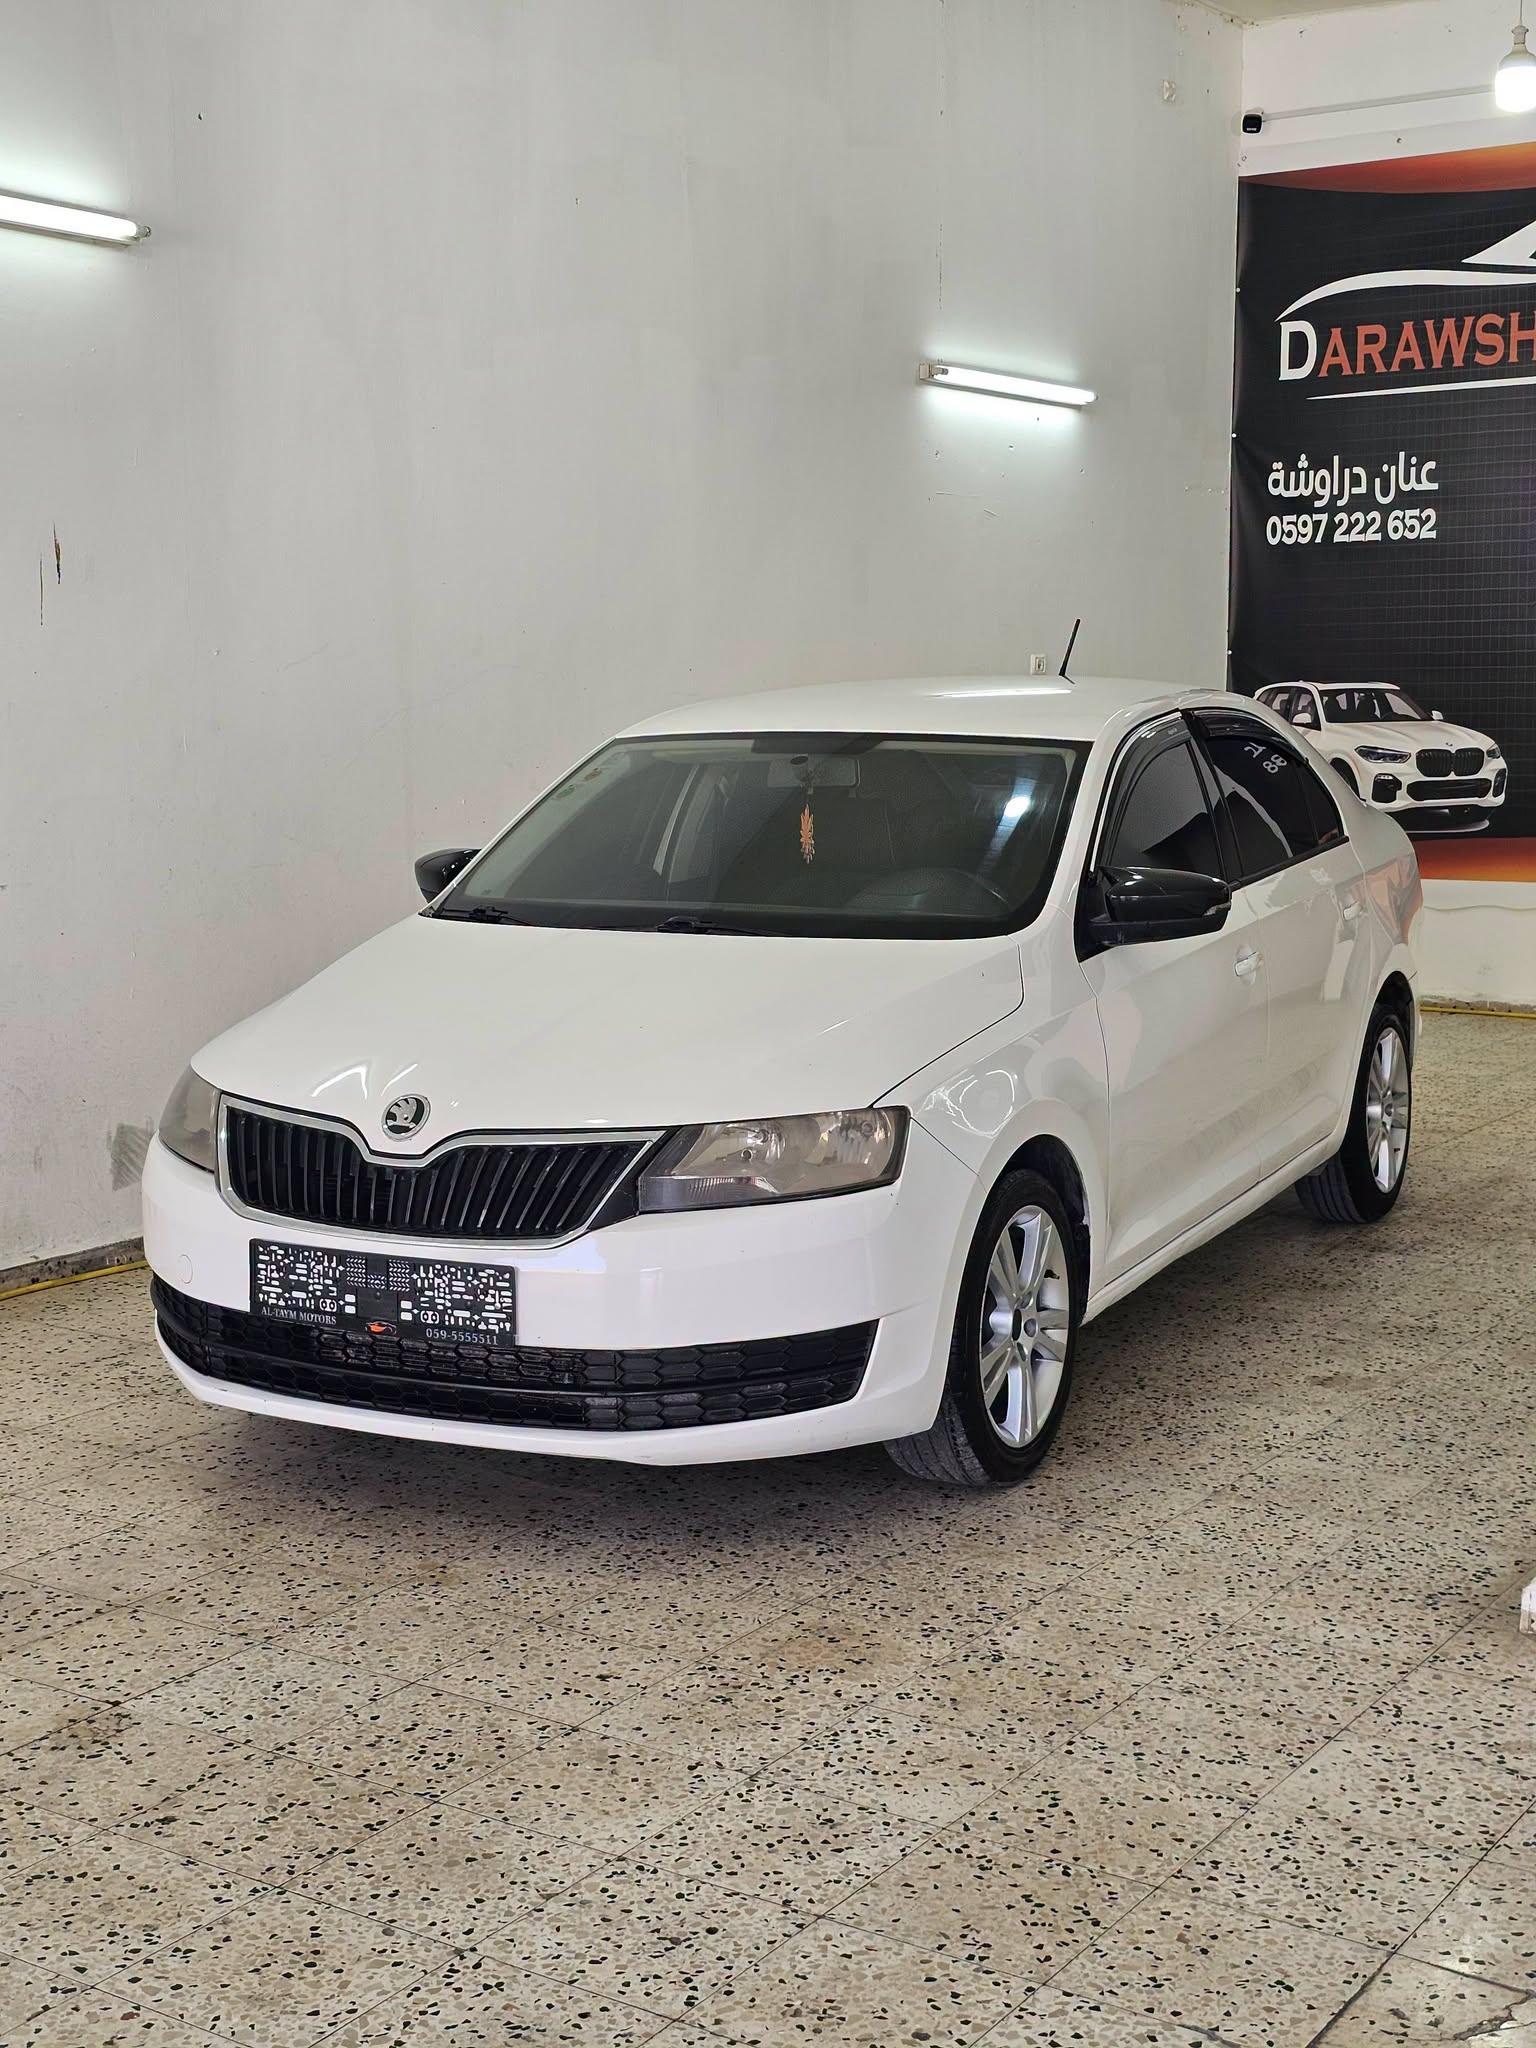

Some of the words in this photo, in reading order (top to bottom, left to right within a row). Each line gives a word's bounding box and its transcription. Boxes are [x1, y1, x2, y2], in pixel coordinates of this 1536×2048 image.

[1278, 310, 1536, 382] DARAWSH
[1267, 453, 1368, 508] دراوشة
[1374, 451, 1439, 505] عنان
[1266, 512, 1329, 546] 0597
[1333, 510, 1382, 543] 222
[1387, 507, 1437, 540] 652
[261, 1306, 297, 1320] AL-TAYM
[299, 1311, 337, 1326] MOTORS
[425, 1327, 499, 1346] 059-5555511
